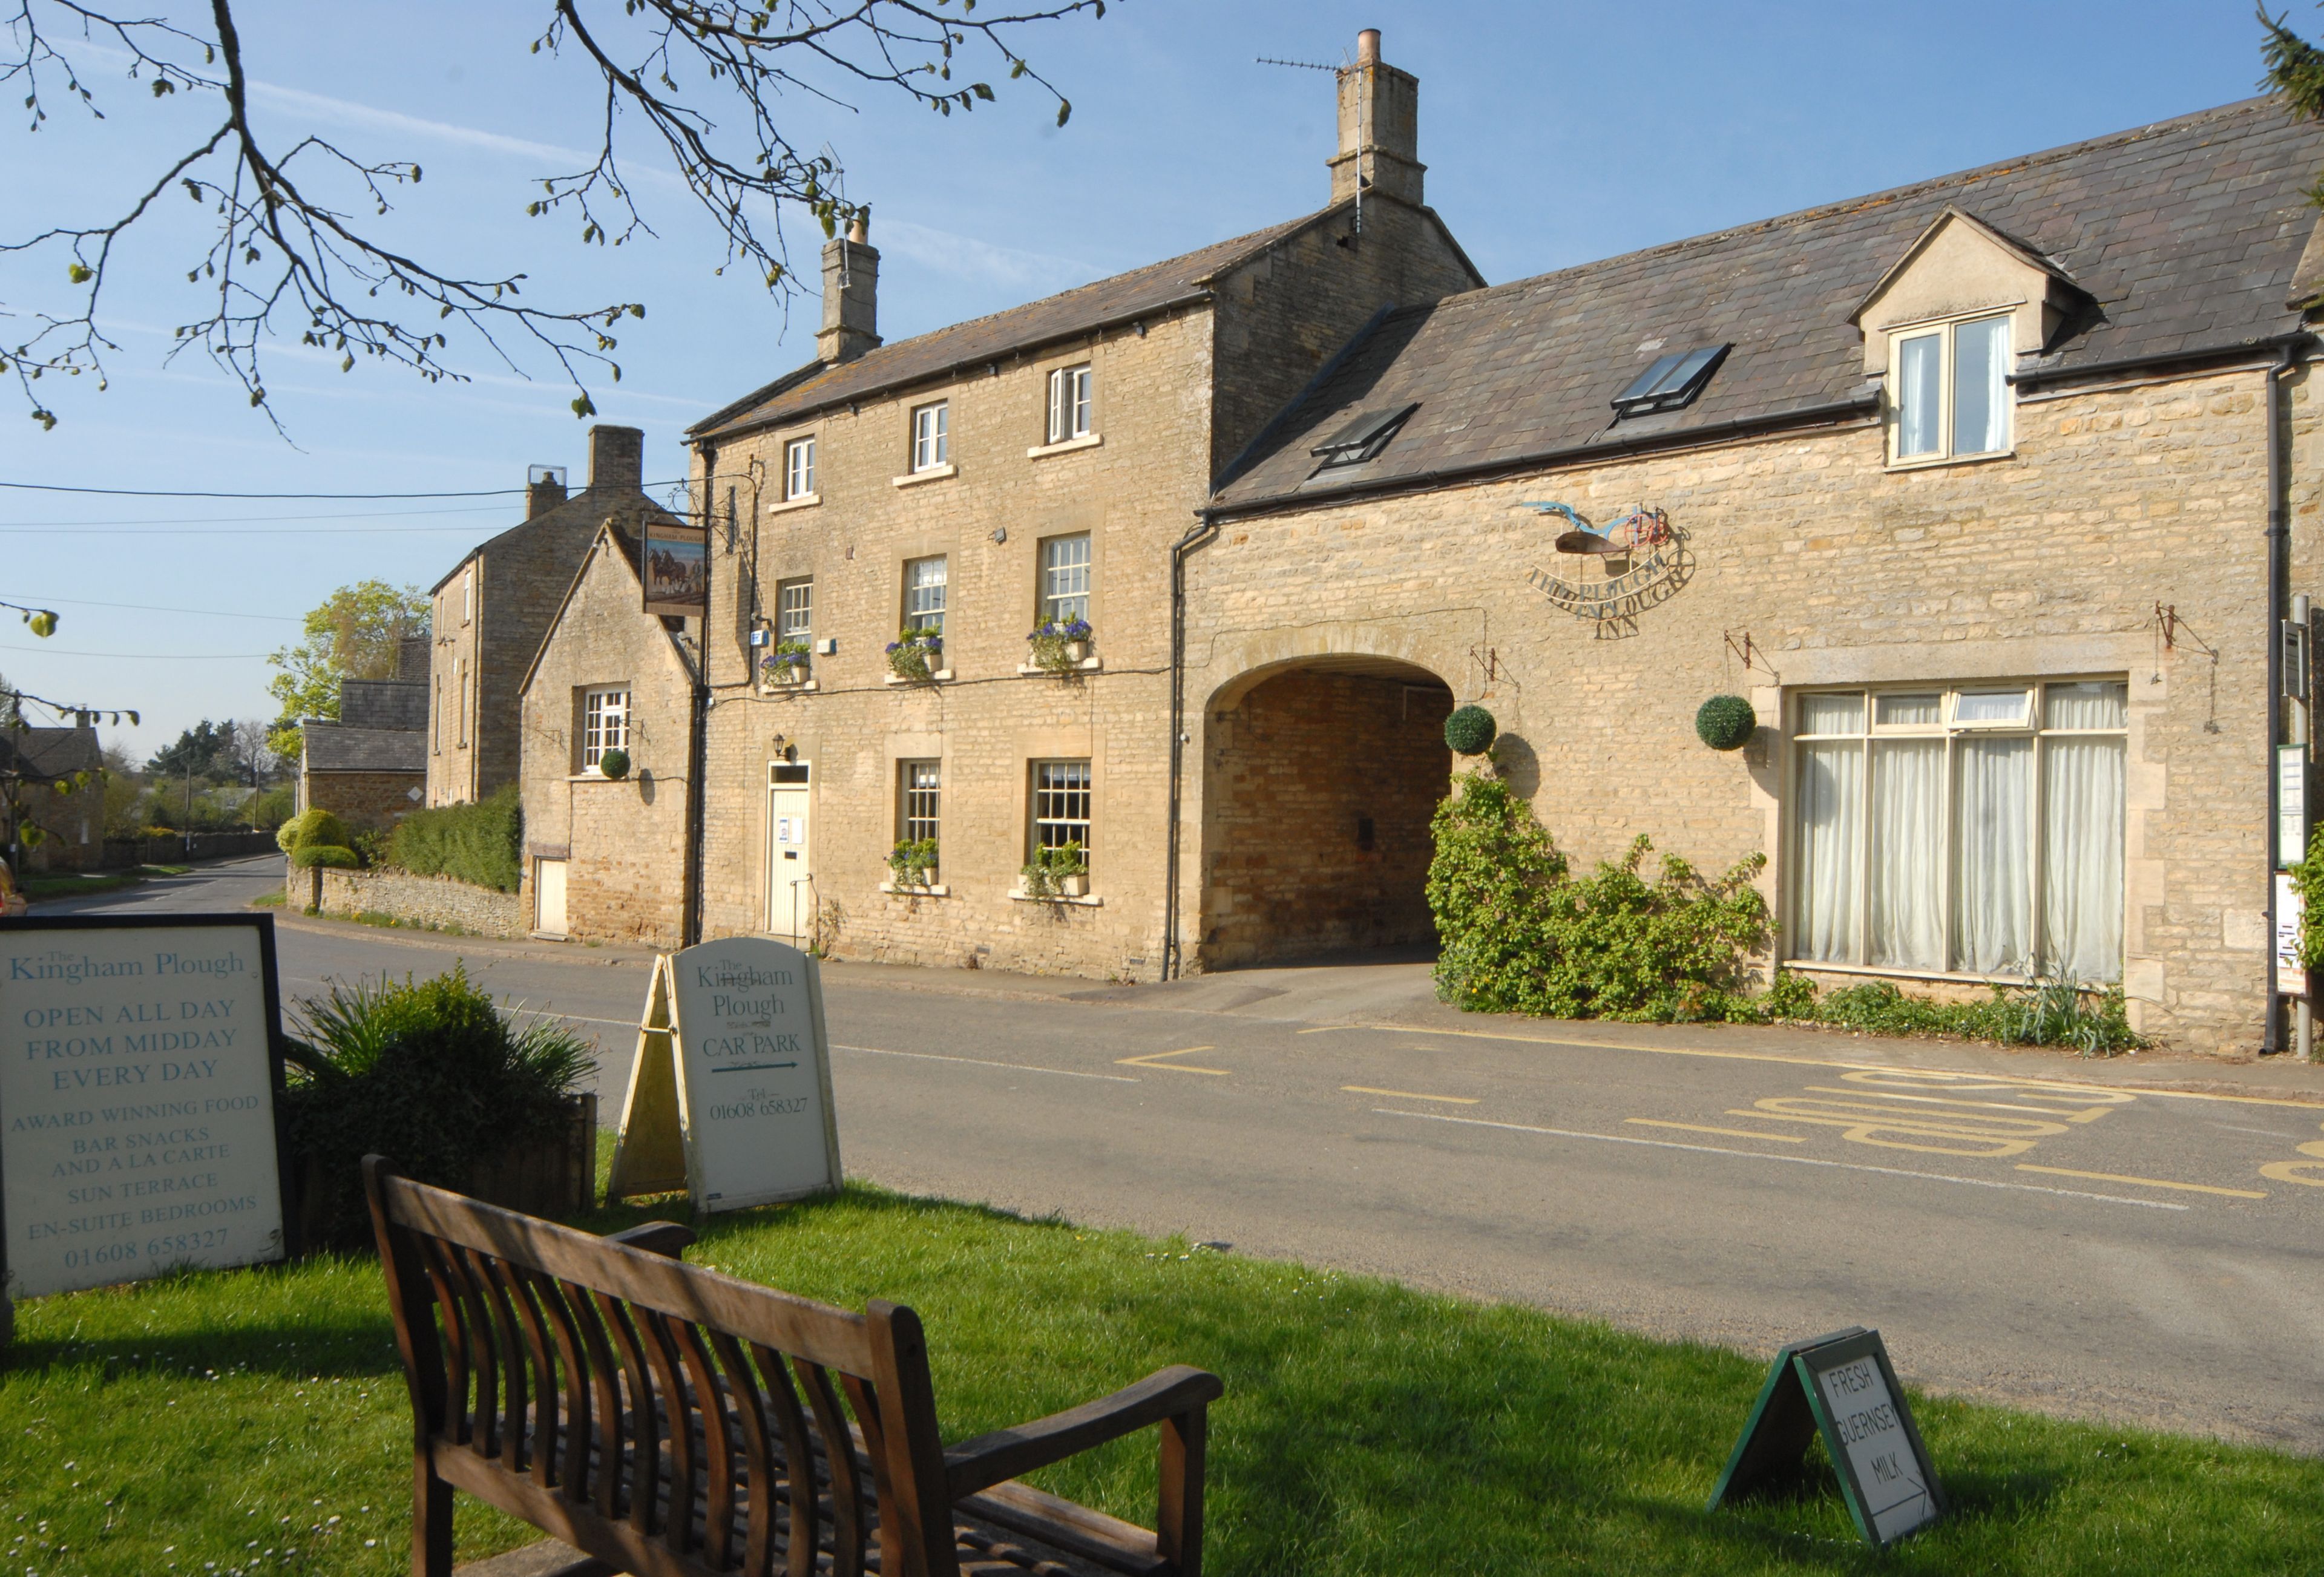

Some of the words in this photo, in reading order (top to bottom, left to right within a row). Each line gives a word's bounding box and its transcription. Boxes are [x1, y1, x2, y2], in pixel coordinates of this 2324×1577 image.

[1579, 552, 1666, 601] PLOUGH
[1576, 602, 1619, 621] INN
[9, 956, 143, 985] Kingham
[155, 951, 244, 979] Plough
[47, 951, 74, 962] The
[720, 960, 742, 971] The
[698, 966, 793, 992] Kingham
[24, 1006, 104, 1028] OPEN
[116, 1003, 171, 1023] ALL
[181, 1000, 235, 1019] DAY
[713, 994, 784, 1020] Plough
[26, 1036, 113, 1060] FROM
[124, 1029, 237, 1054] MIDDAY
[703, 1037, 747, 1057] CAR
[753, 1034, 800, 1054] PARK
[54, 1065, 151, 1089] EVERY
[162, 1059, 217, 1081] DAY
[11, 1111, 93, 1132] AWARD
[102, 1101, 197, 1122] WINNING
[205, 1095, 258, 1112] FOOD
[710, 1102, 755, 1120] 01608
[760, 1098, 807, 1115] 658327
[1725, 1070, 2137, 1157] STOP
[73, 1138, 117, 1154] BAR
[126, 1127, 209, 1149] SNACKS
[52, 1160, 99, 1177] AND
[108, 1157, 122, 1171] A
[129, 1153, 157, 1169] LA
[163, 1144, 230, 1165] CARTE
[68, 1187, 113, 1204] SUN
[121, 1173, 217, 1198] TERRACE
[29, 1213, 133, 1239] EN-SUITE
[141, 1196, 257, 1224] BEDROOMS
[65, 1242, 136, 1268] 01608
[147, 1228, 228, 1255] 658327
[1829, 1363, 1874, 1398] FRESH
[1837, 1403, 1899, 1446] GUERNSEY
[1871, 1452, 1903, 1485] MILK
